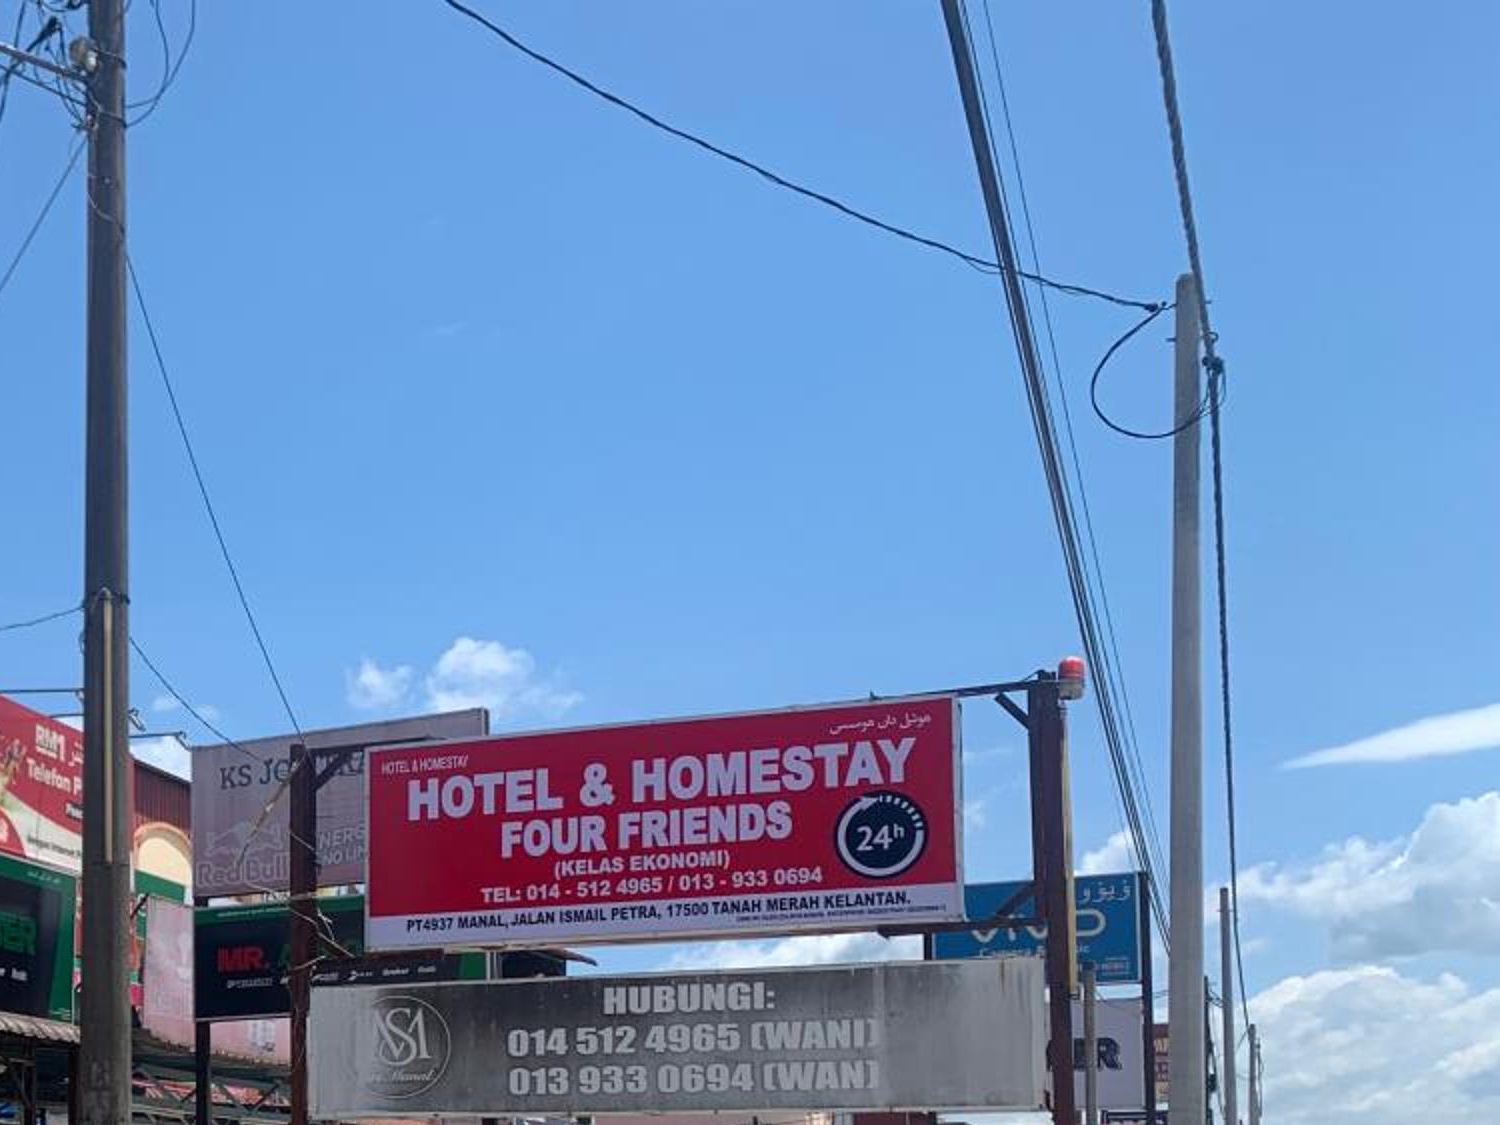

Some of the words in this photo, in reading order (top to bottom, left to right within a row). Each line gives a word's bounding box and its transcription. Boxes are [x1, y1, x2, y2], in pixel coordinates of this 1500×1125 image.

[26, 757, 72, 793] Telefon
[381, 758, 410, 775] HOTEL
[419, 754, 469, 772] HOMESTAY
[406, 767, 565, 822] HOTEL
[579, 762, 616, 808] &
[631, 736, 917, 804] HOMESTAY
[500, 814, 608, 859] FOUR
[616, 800, 794, 850] FRIENDS
[554, 855, 625, 881] (KELAS
[629, 849, 731, 873] EKONOMI)
[481, 886, 521, 904] TEL:
[526, 883, 560, 900] 014
[576, 881, 611, 898] 512
[615, 877, 663, 895] 4965
[678, 872, 715, 892] 013
[731, 870, 769, 889] 933
[773, 866, 823, 887] 0694
[406, 917, 453, 933] PT4937
[511, 911, 555, 927] JALAN
[559, 908, 607, 924] ISMAIL
[666, 901, 710, 918] 17500
[712, 899, 762, 916] TANAH
[765, 895, 821, 912] MERAH
[823, 891, 912, 909] KELANTAN.
[602, 981, 776, 1016] HUBUNGI:
[506, 1028, 569, 1058] 014
[575, 1025, 637, 1055] 512
[644, 1021, 741, 1054] 4965
[508, 1066, 570, 1096] 013
[578, 1064, 648, 1096] 933
[656, 1062, 755, 1095] 0694
